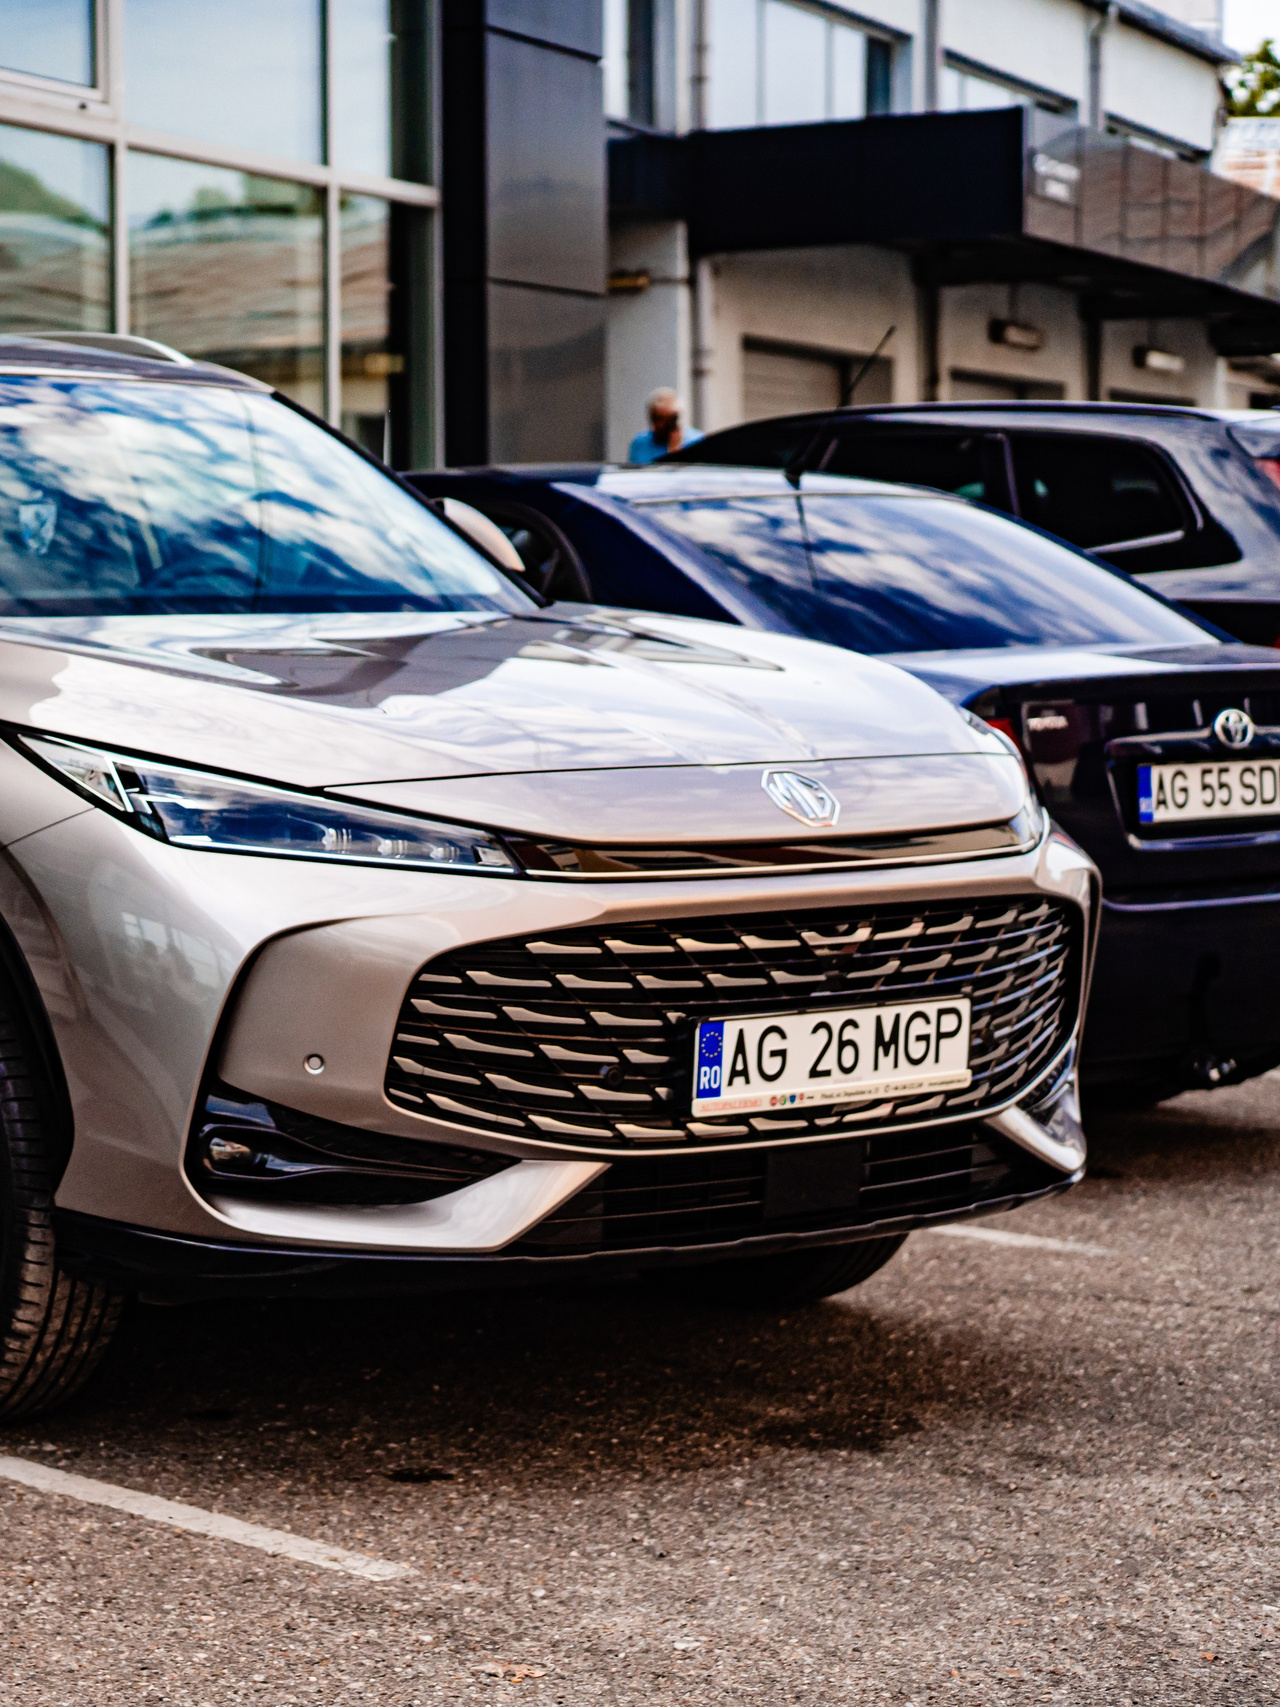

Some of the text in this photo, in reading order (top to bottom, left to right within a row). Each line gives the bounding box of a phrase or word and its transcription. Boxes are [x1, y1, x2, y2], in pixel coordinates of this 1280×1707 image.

[768, 772, 832, 820] MG
[1155, 764, 1280, 811] AG 55 SD
[726, 1006, 963, 1087] AG 26 MGP
[699, 1065, 721, 1090] RO
